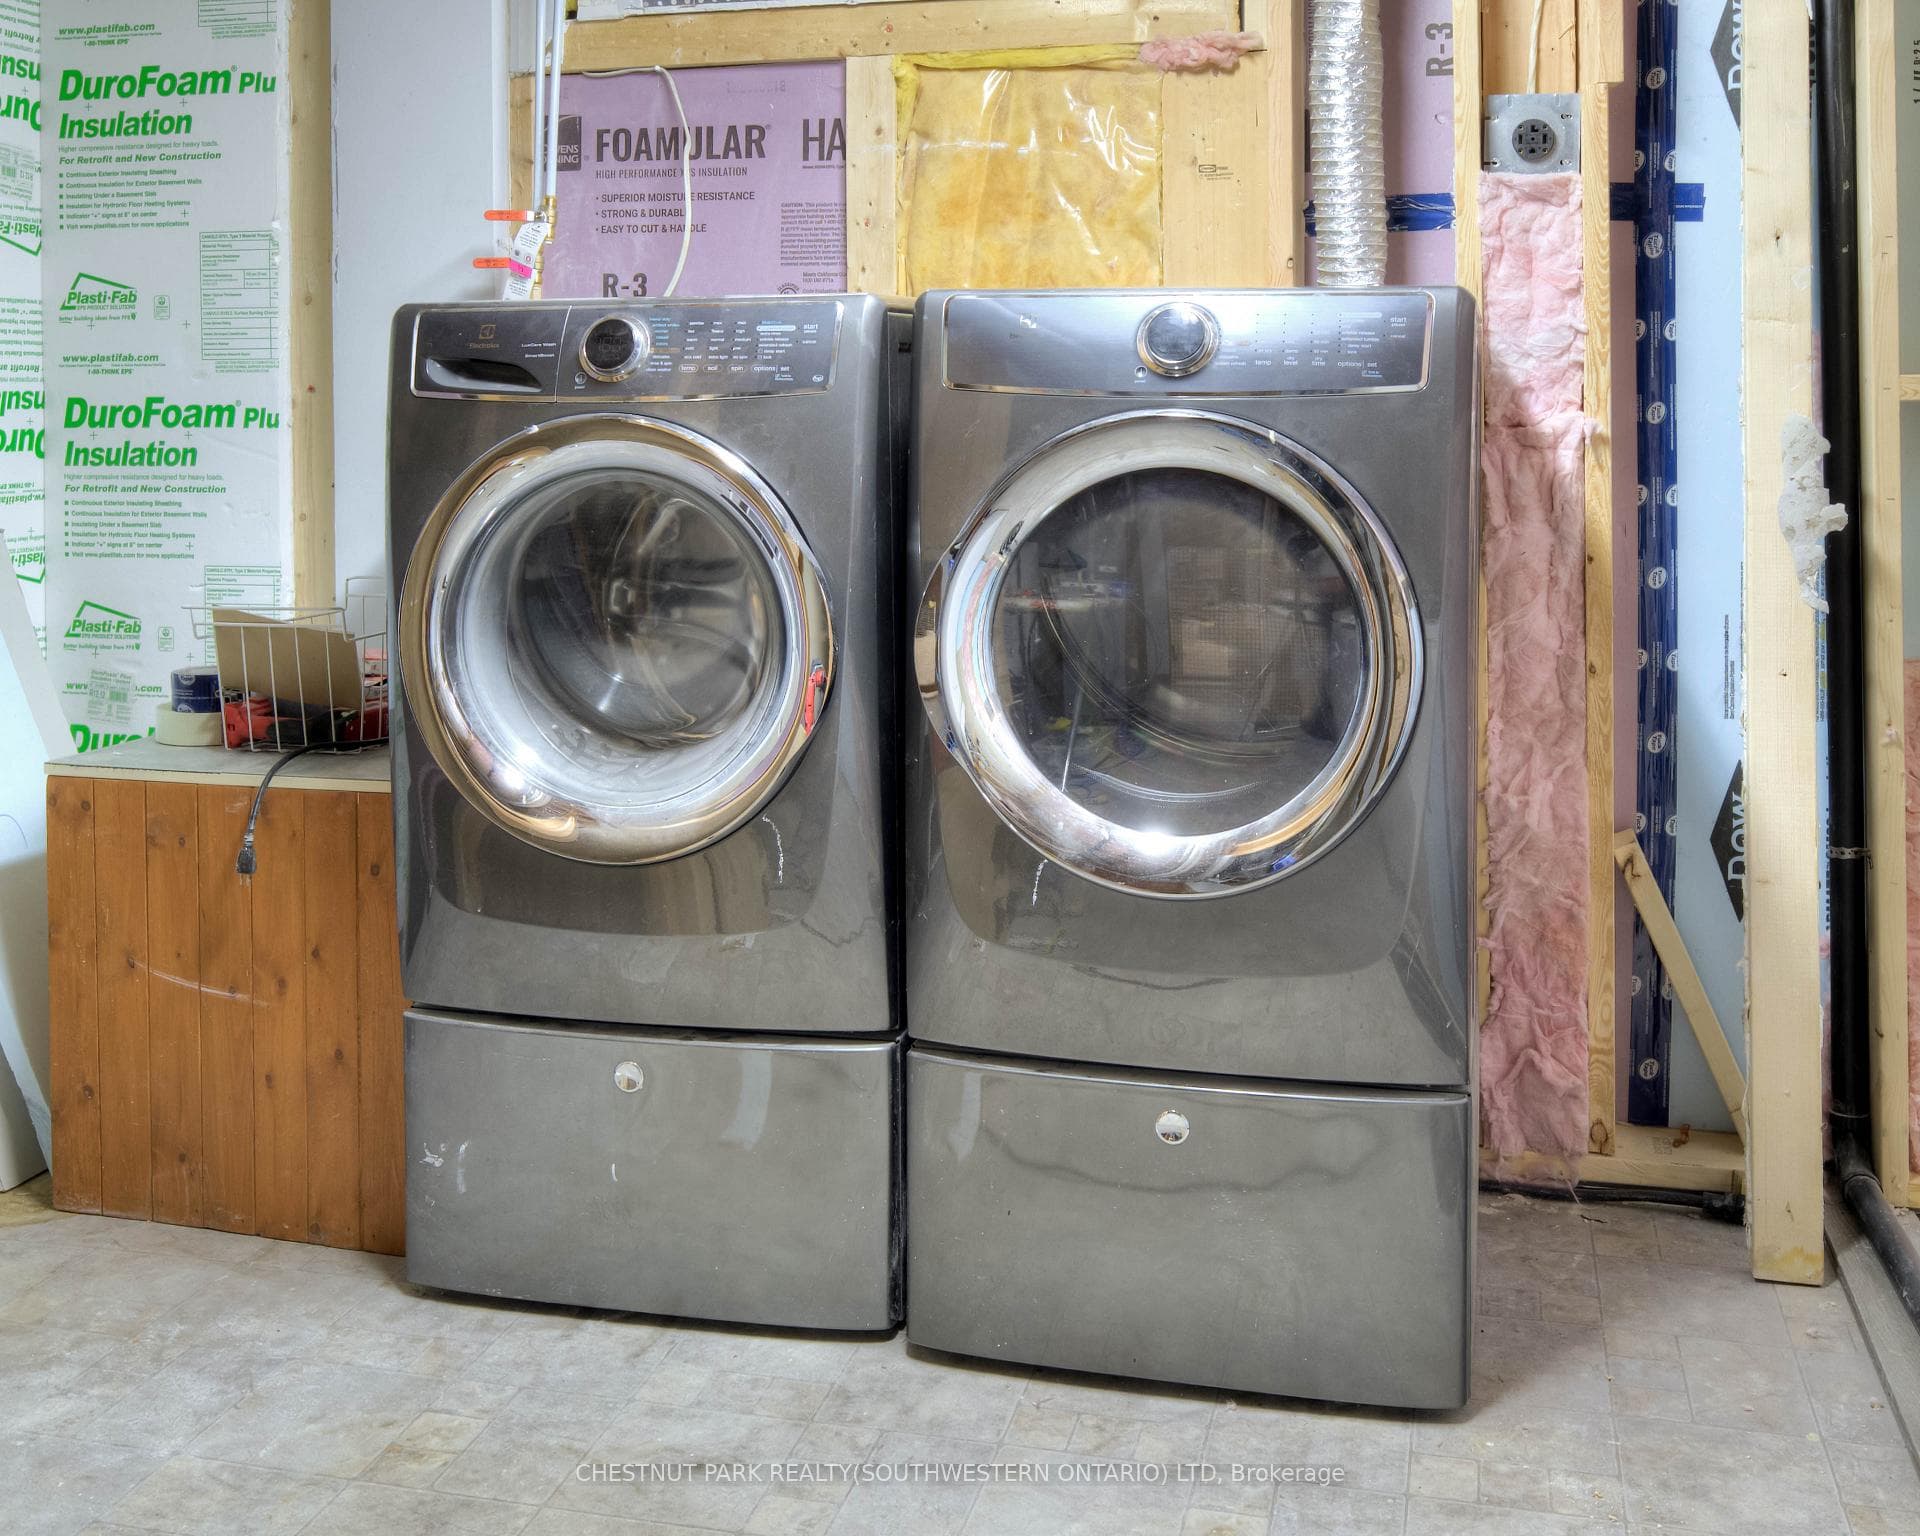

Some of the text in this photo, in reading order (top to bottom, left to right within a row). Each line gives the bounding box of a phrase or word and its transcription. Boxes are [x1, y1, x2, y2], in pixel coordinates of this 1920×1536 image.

[58, 22, 155, 35] www.plastifab.com
[1425, 22, 1454, 77] R-3
[59, 109, 192, 139] Insulation
[59, 151, 221, 164] For Retrofit and New Construction
[596, 170, 616, 179] HIGH
[618, 168, 677, 178] PERFORMANCE
[699, 166, 748, 176] INSULATION
[602, 193, 646, 203] SUPERIOR
[698, 191, 755, 201] RESISTANCE
[601, 208, 684, 218] STRONG & DURABL
[602, 224, 624, 234] EASY
[626, 224, 638, 233] TO
[641, 224, 659, 233] CUT
[662, 224, 667, 233] &
[602, 272, 648, 297] R-3
[63, 353, 159, 364] www.plastifab.com
[64, 440, 198, 467] Insulation
[64, 484, 226, 493] For Retrofit and New Construction
